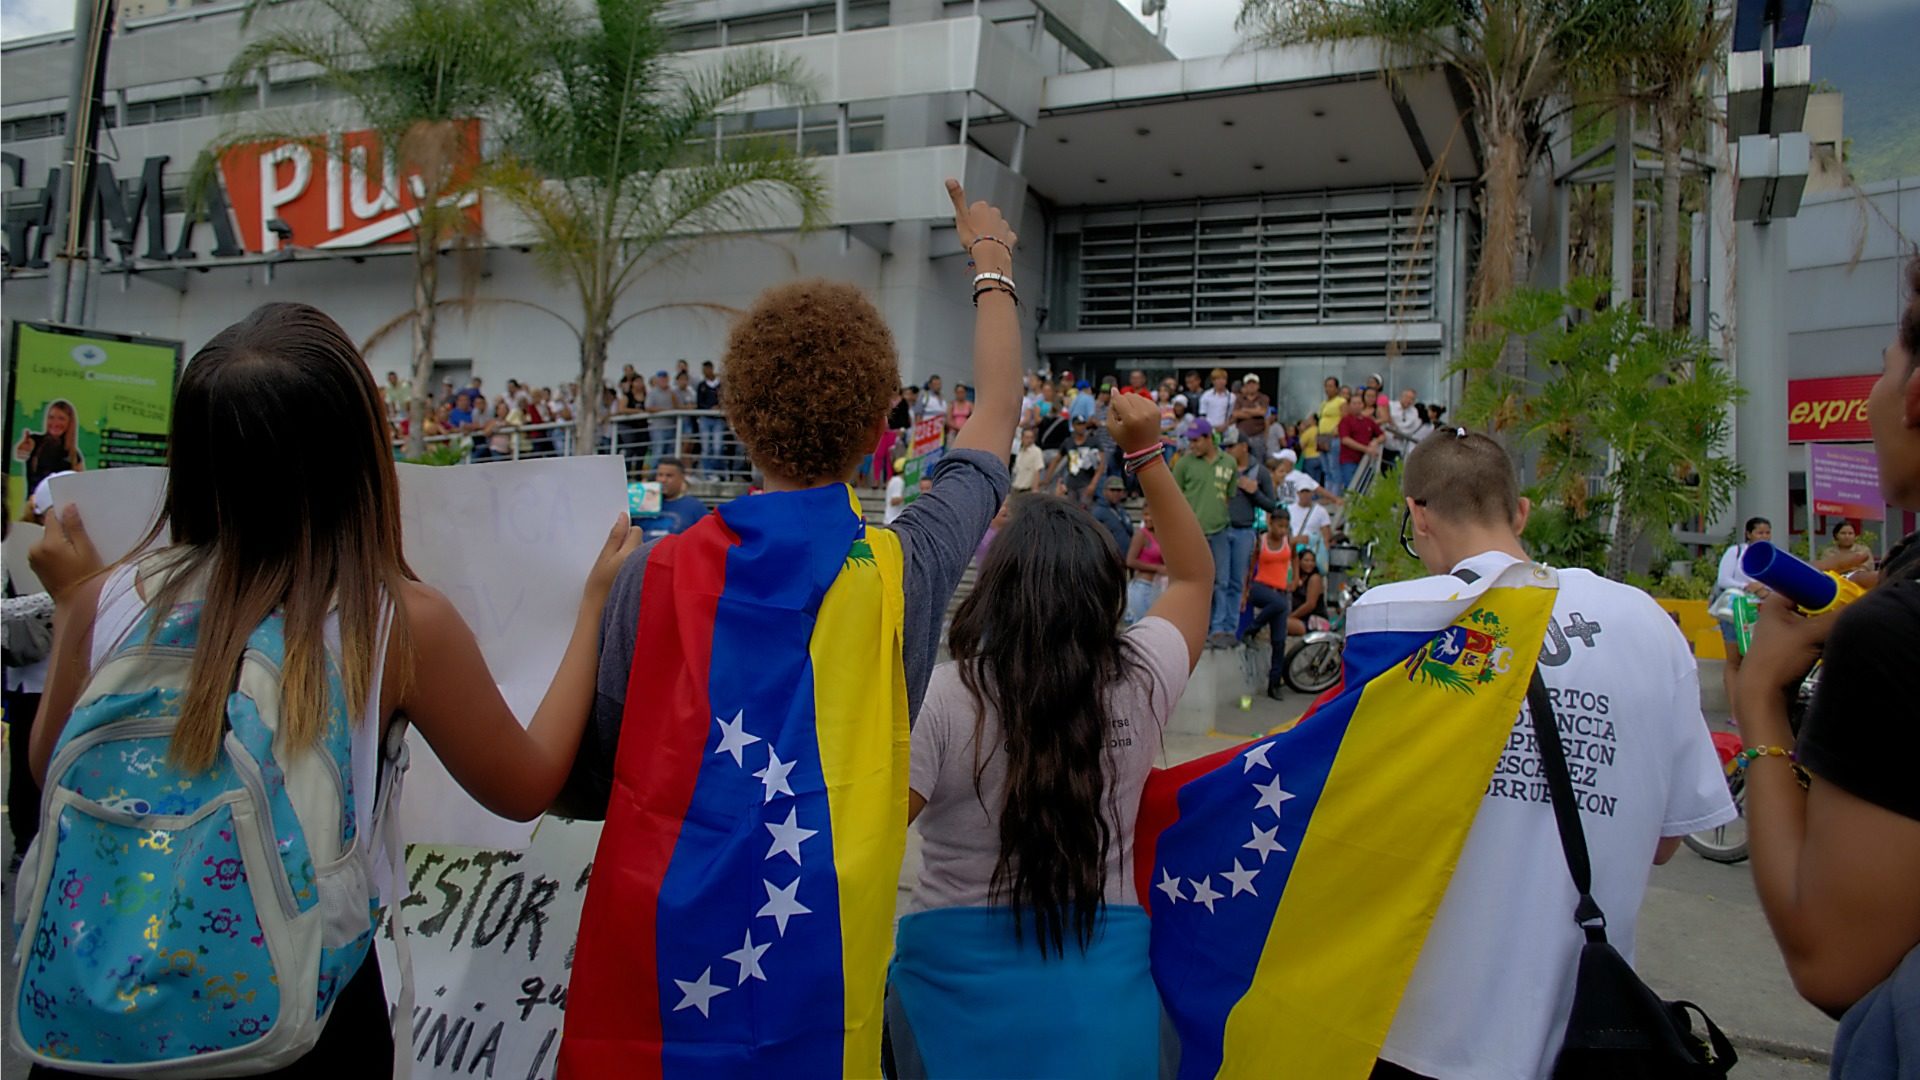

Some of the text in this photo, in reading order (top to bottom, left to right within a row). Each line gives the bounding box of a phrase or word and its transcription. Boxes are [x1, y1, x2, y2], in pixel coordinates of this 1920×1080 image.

[259, 126, 440, 254] Plu
[1494, 755, 1597, 787] ESCAEZ
[378, 843, 560, 962] ESTOR
